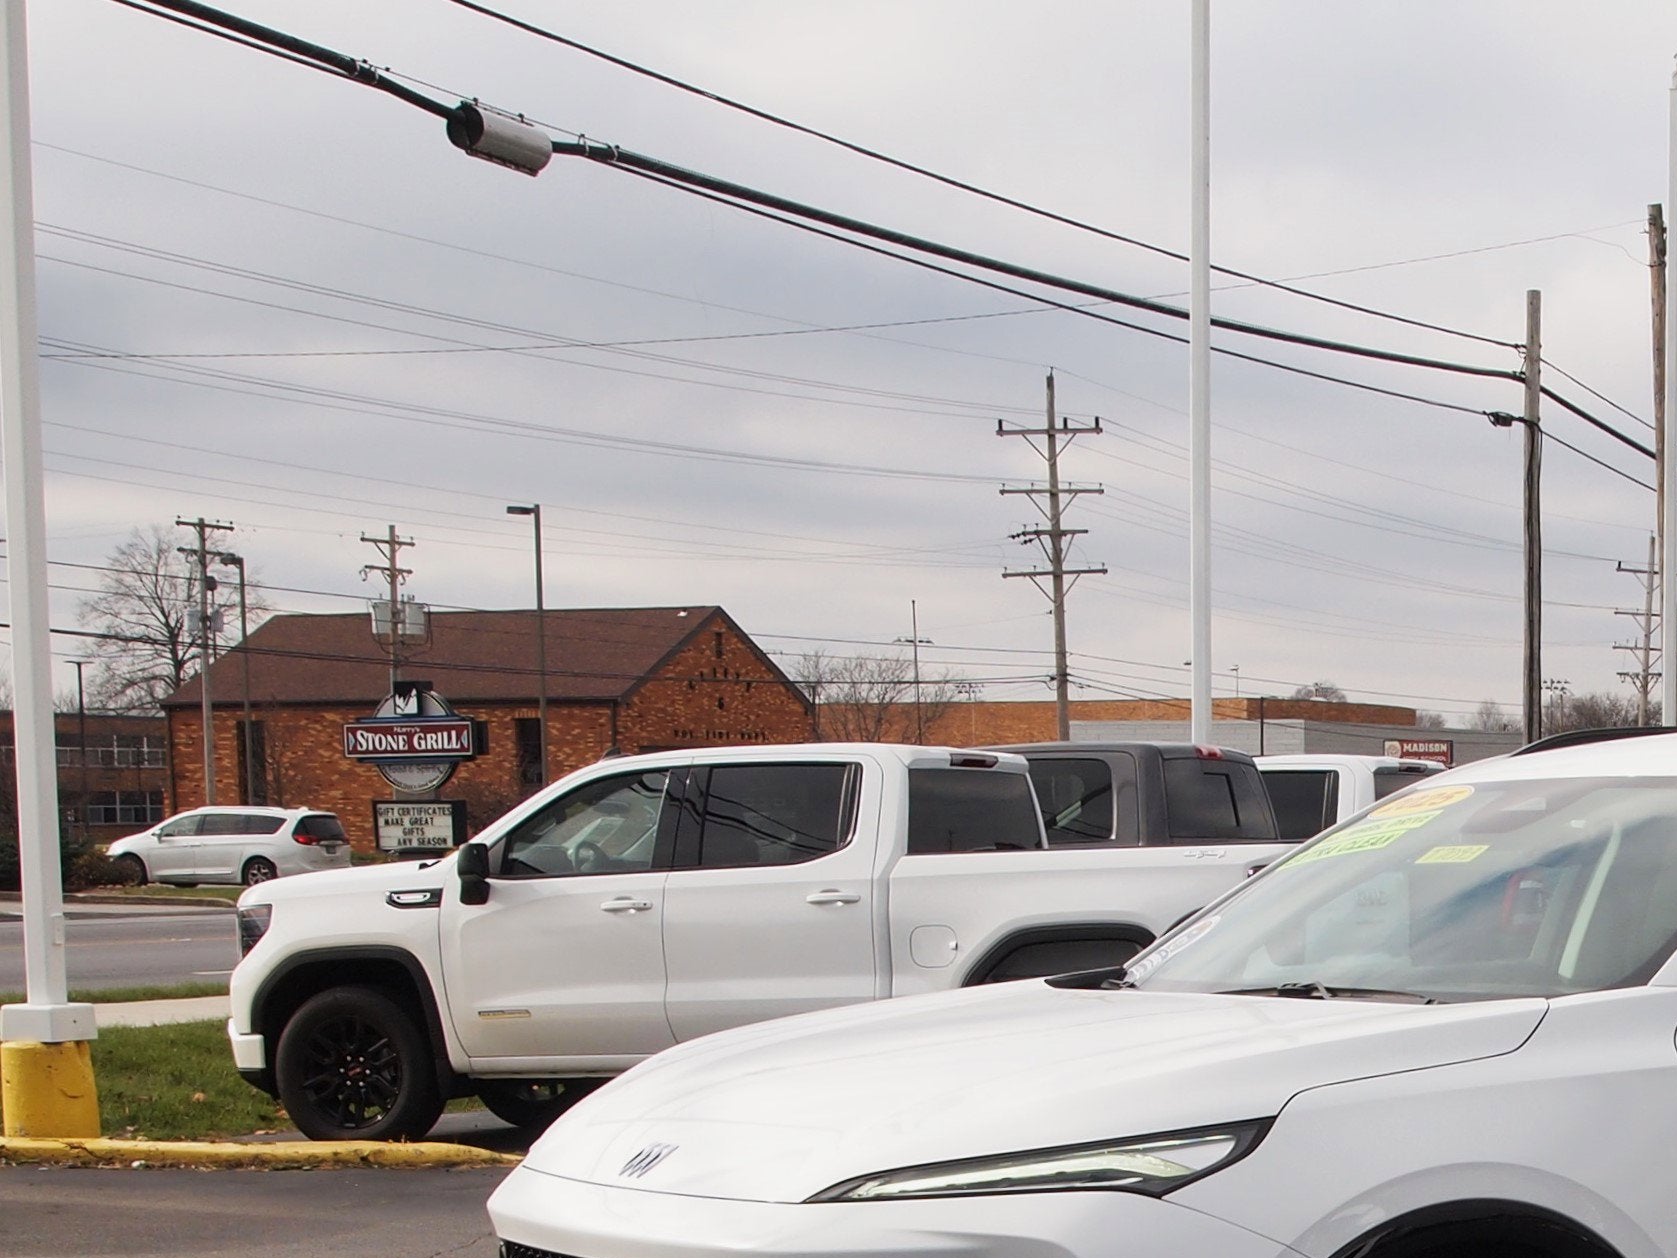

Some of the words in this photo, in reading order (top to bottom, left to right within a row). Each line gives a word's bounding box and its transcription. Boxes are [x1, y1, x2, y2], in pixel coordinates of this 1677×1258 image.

[356, 730, 408, 750] STONE
[413, 729, 461, 749] GRILL
[1403, 742, 1448, 752] MADISON
[378, 807, 395, 816] GIFT
[397, 806, 452, 816] CERTIFICATES
[384, 817, 404, 826] MAKE
[409, 817, 434, 826] GREAT
[402, 827, 425, 836] GIFTS
[417, 837, 448, 846] SEASON
